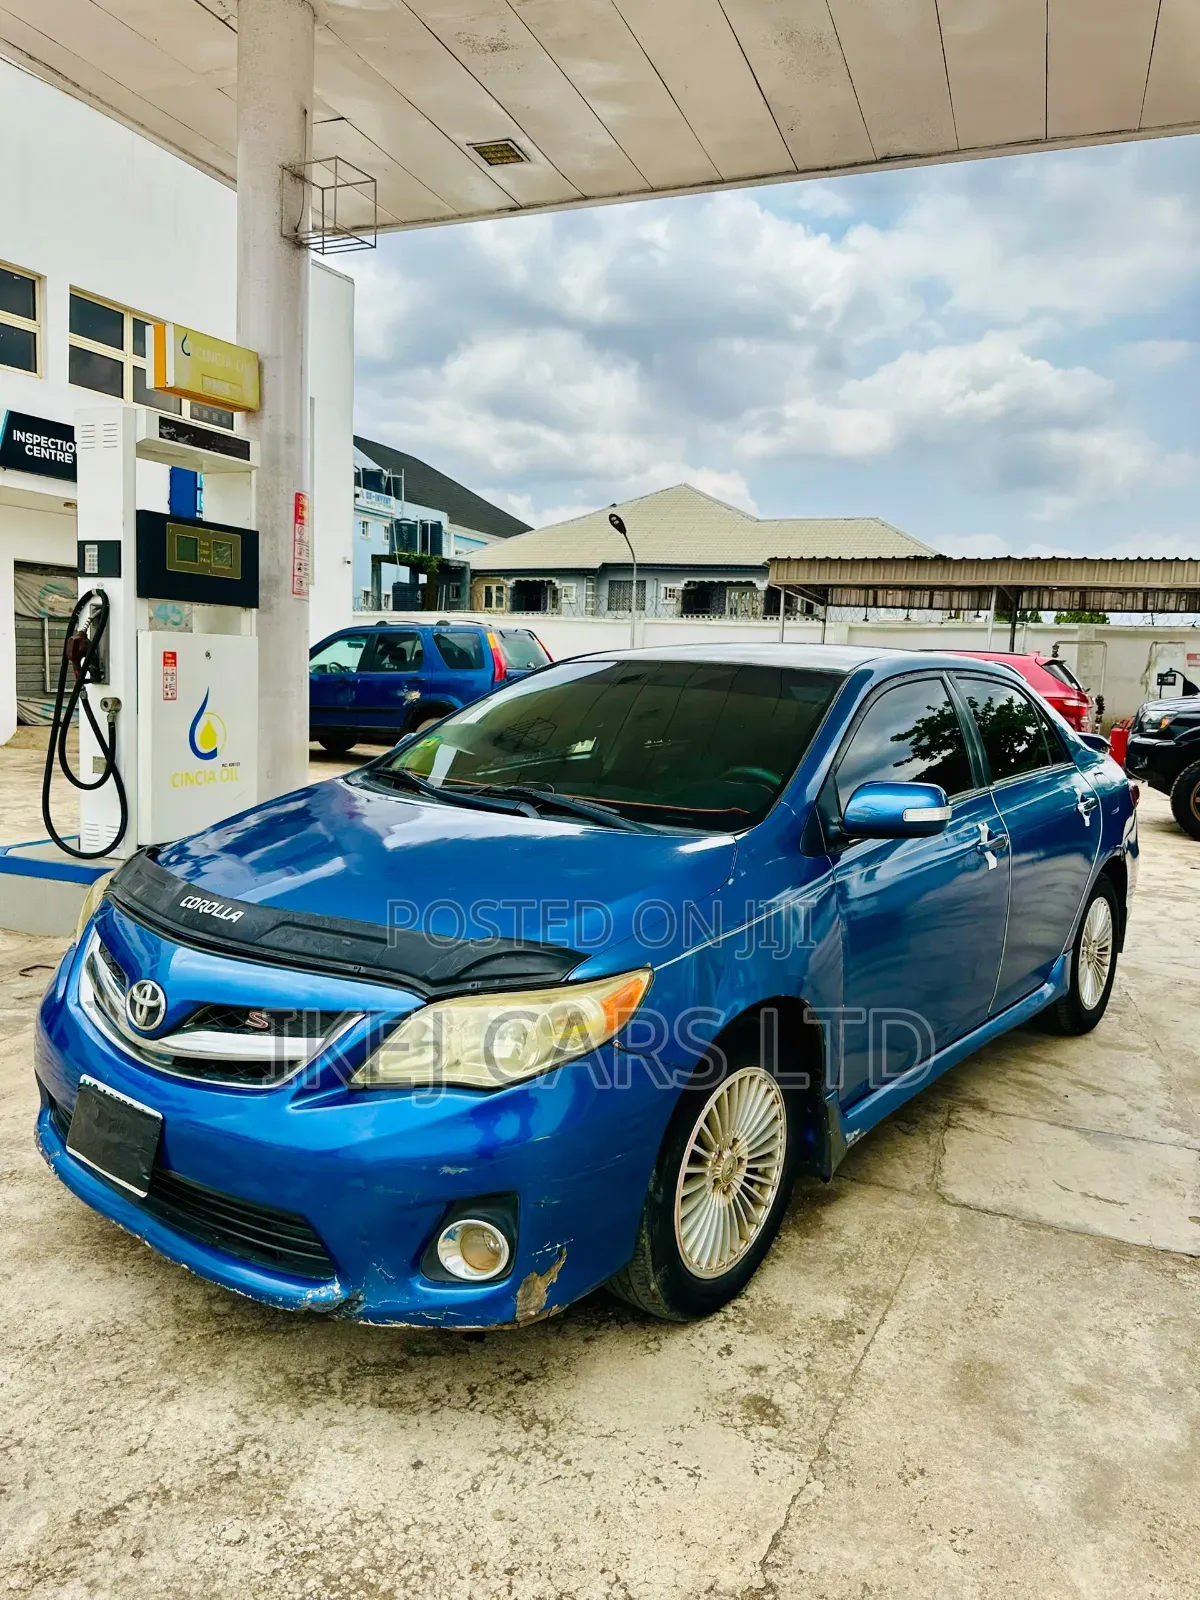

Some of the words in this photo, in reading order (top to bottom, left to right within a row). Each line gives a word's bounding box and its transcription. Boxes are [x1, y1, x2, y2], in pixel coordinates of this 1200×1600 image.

[13, 429, 77, 453] INSPECTIO
[25, 444, 73, 464] CENTRE
[171, 769, 217, 788] CINCIA
[220, 767, 240, 783] OIL
[180, 895, 244, 923] COROLLA
